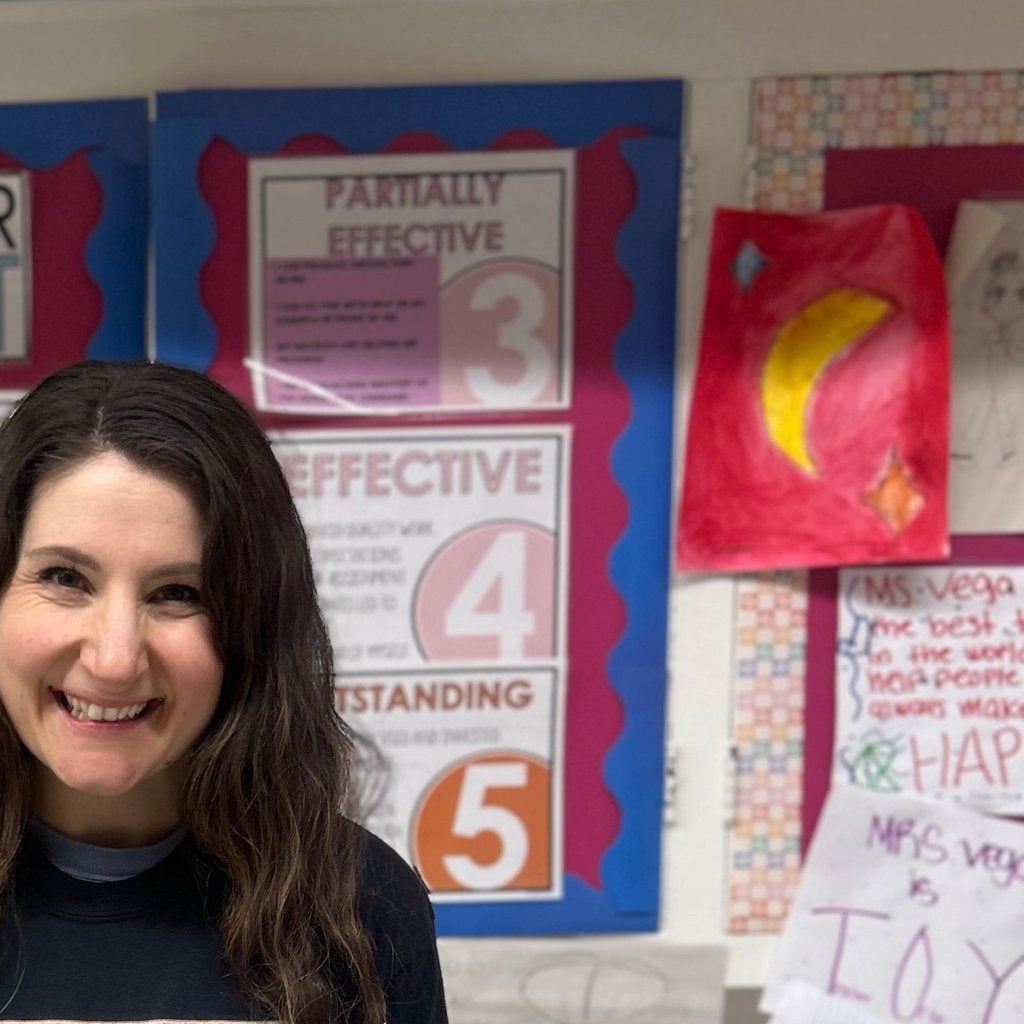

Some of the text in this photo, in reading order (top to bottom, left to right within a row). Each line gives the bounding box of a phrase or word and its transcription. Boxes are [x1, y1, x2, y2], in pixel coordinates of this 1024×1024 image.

[324, 171, 507, 210] PARTIALLY
[328, 221, 505, 257] EFFECTIVE
[464, 271, 553, 407] 3
[282, 448, 543, 499] EFFECTIVE
[444, 530, 536, 662] 4
[335, 680, 535, 714] TSTANDING
[441, 762, 529, 889] 5
